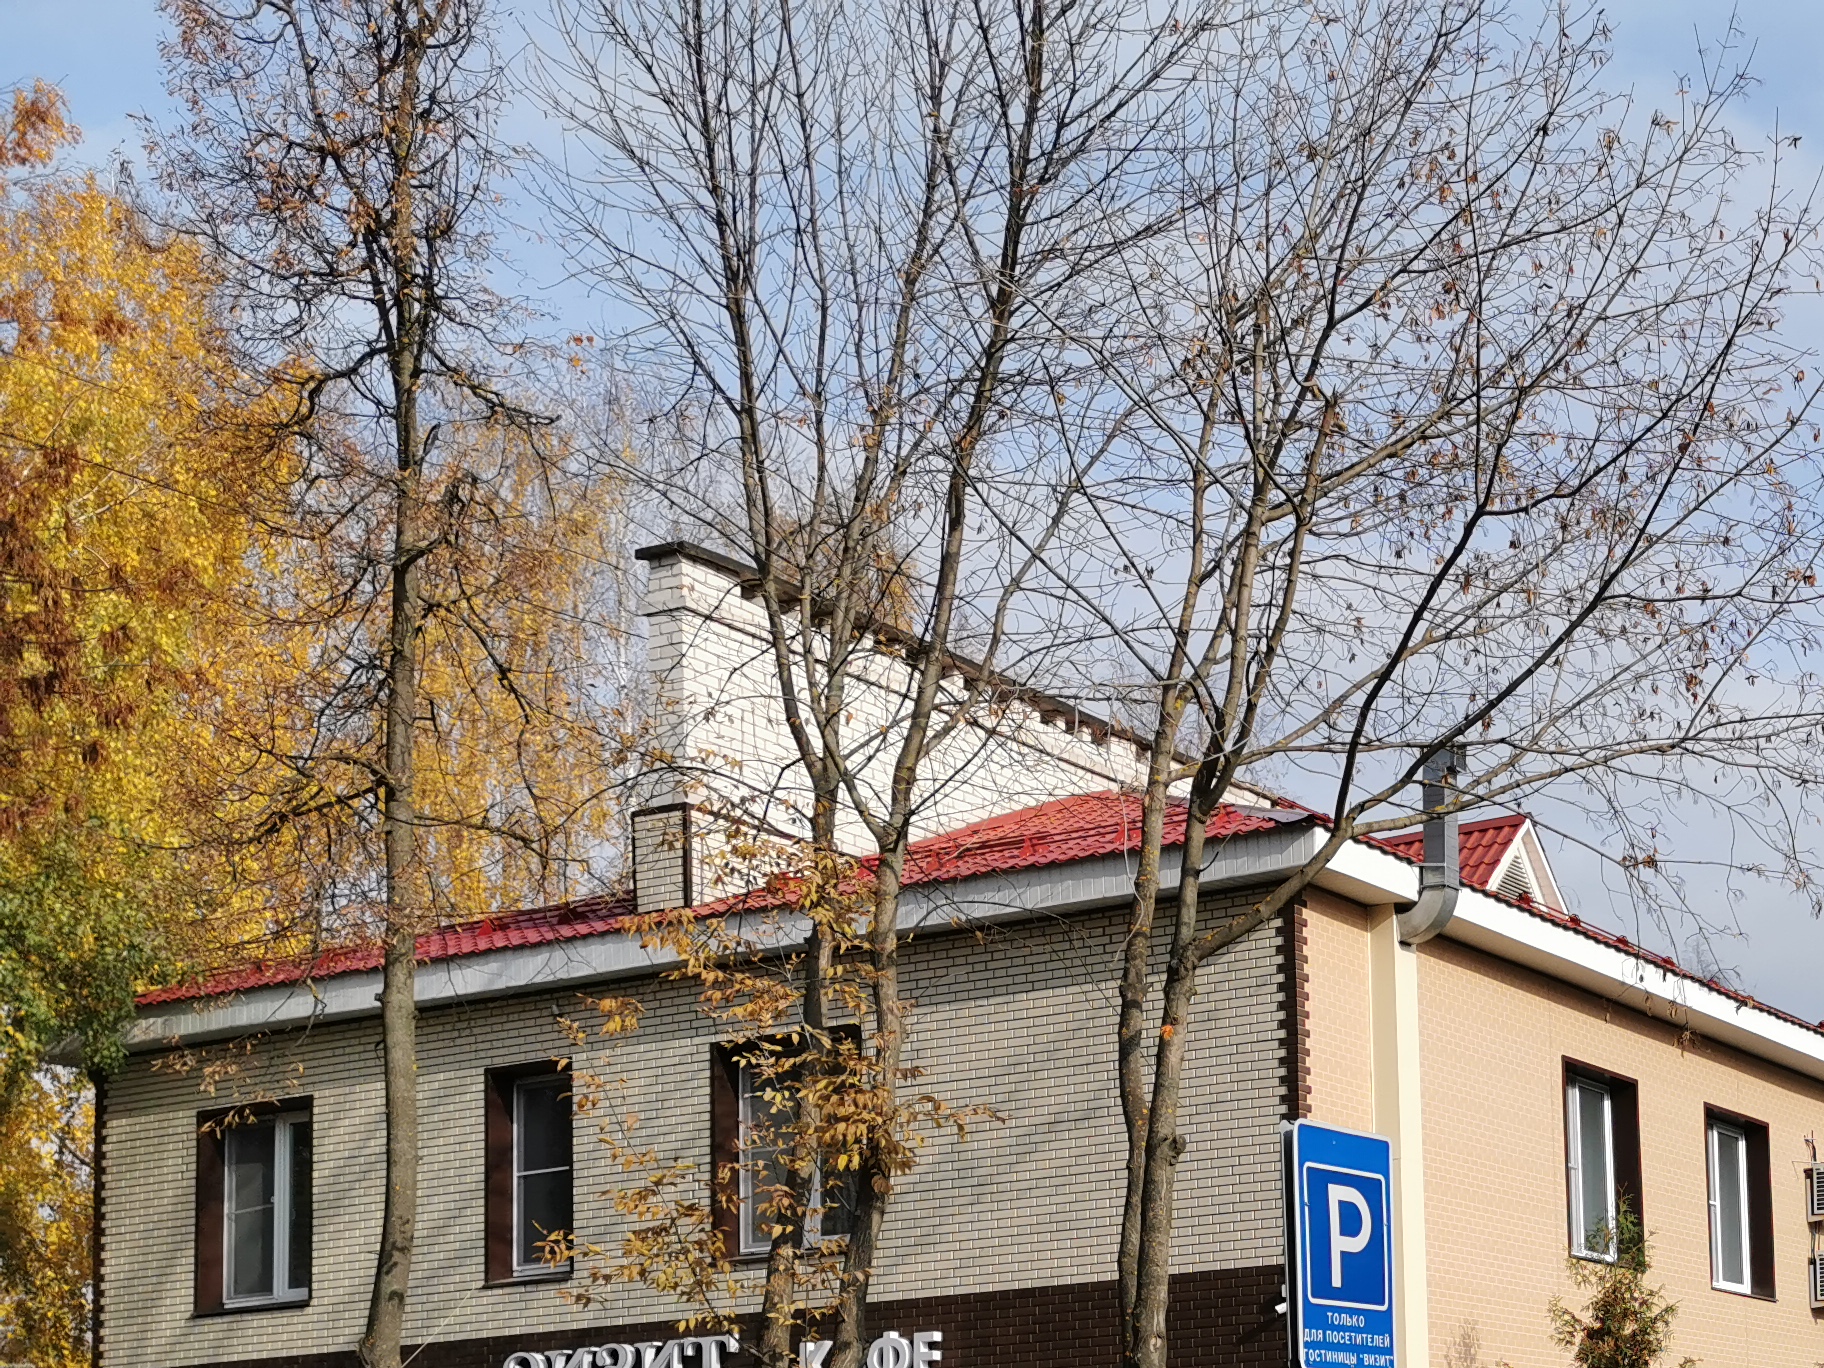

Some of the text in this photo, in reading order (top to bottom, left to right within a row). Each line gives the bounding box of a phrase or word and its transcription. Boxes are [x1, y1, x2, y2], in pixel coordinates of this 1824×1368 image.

[1327, 1183, 1372, 1288] P
[1326, 1312, 1365, 1328] ТОЛЬКО
[1304, 1328, 1390, 1348] ДЛЯ ПОСЕТИТЕЛЕЙ
[1304, 1348, 1357, 1366] ГОСТИНИЦЫ
